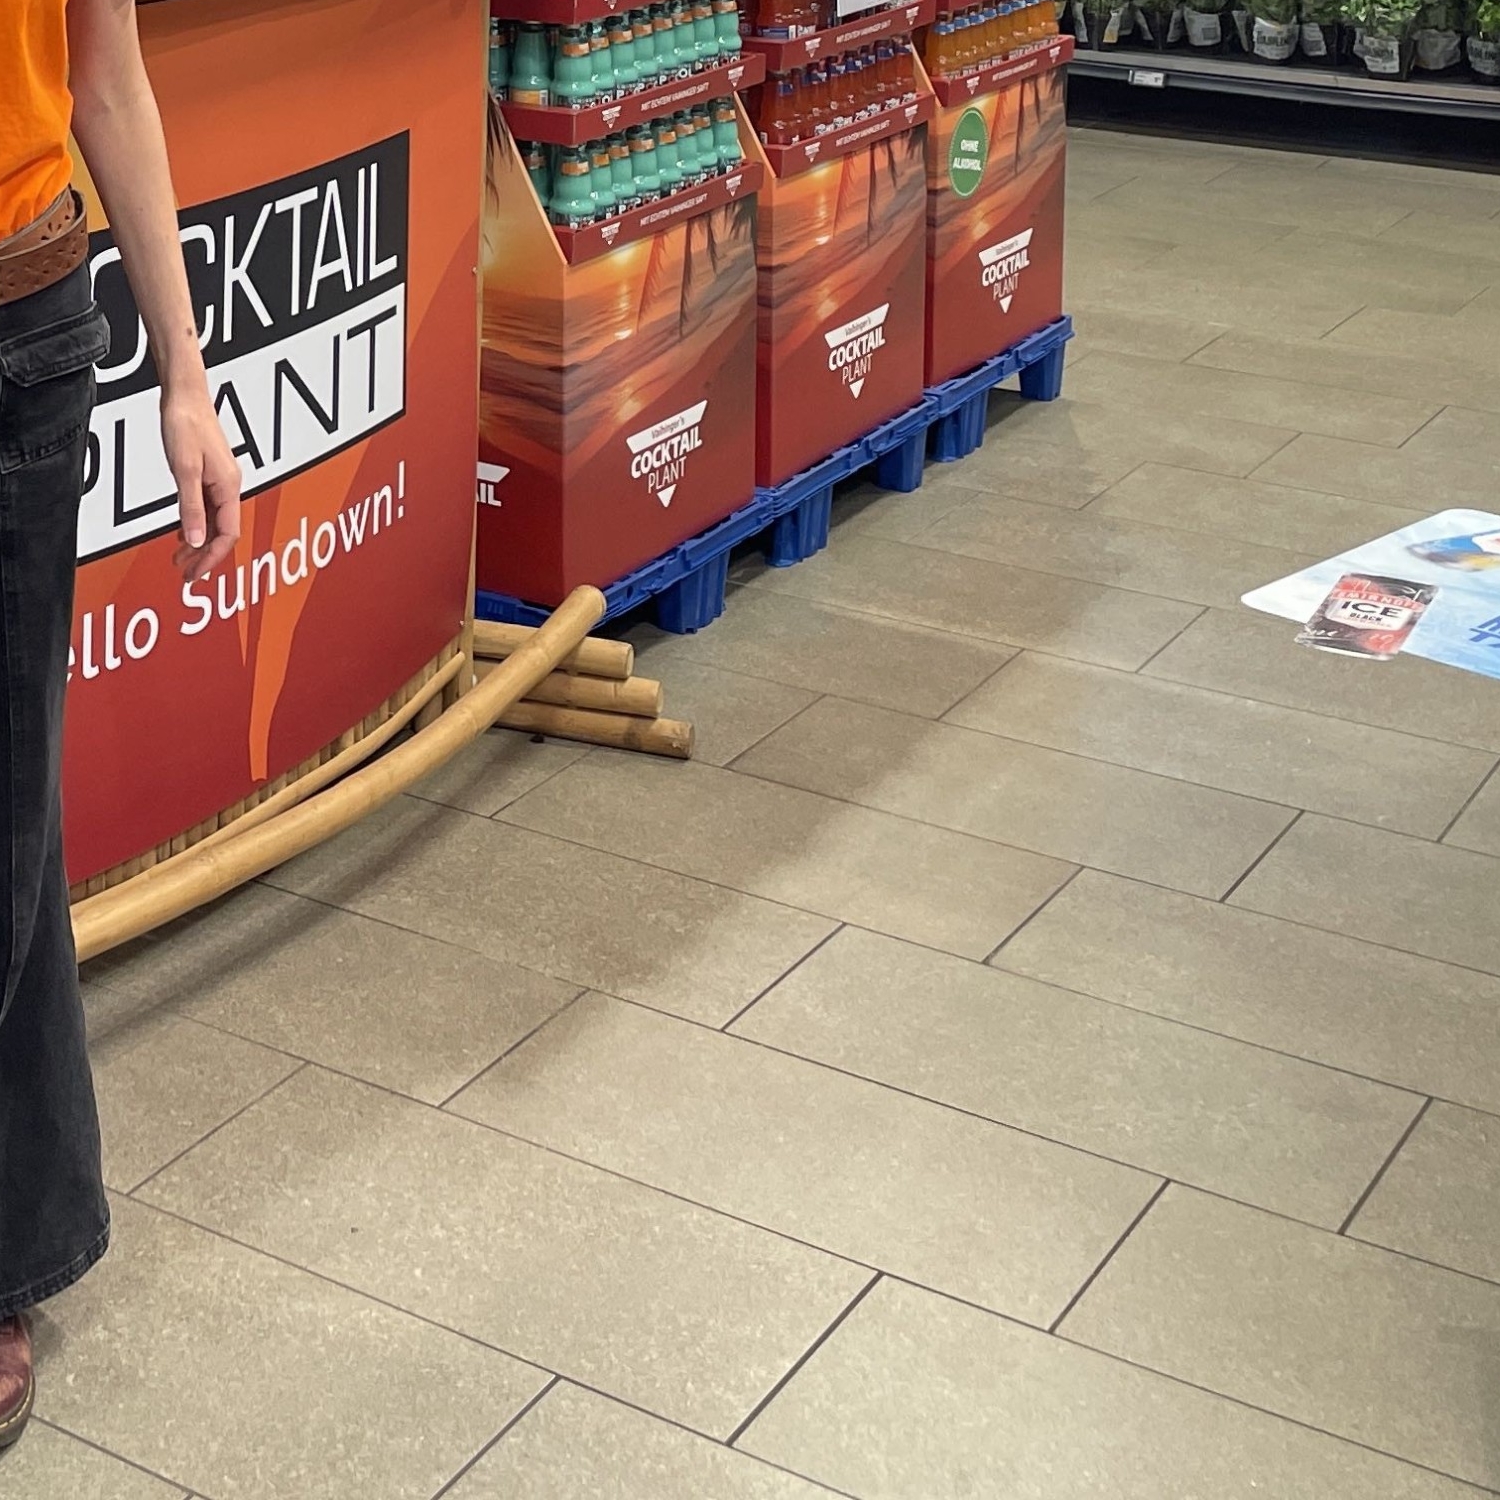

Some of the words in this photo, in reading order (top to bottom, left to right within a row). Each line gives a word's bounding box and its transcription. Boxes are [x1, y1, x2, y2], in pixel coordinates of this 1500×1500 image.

[960, 138, 980, 153] OHNE
[953, 156, 982, 172] ALKOHOL
[982, 248, 1030, 287] COCKTAIL
[993, 272, 1020, 301] PLANT
[828, 325, 886, 371] COCKTAIL
[842, 353, 873, 386] PLANT
[82, 304, 397, 526] LANT
[631, 425, 703, 479] COCKTAIL
[648, 456, 687, 494] PLANT
[180, 461, 405, 636] Sundown!
[1341, 600, 1403, 619] ICE
[1349, 612, 1383, 622] BLACK
